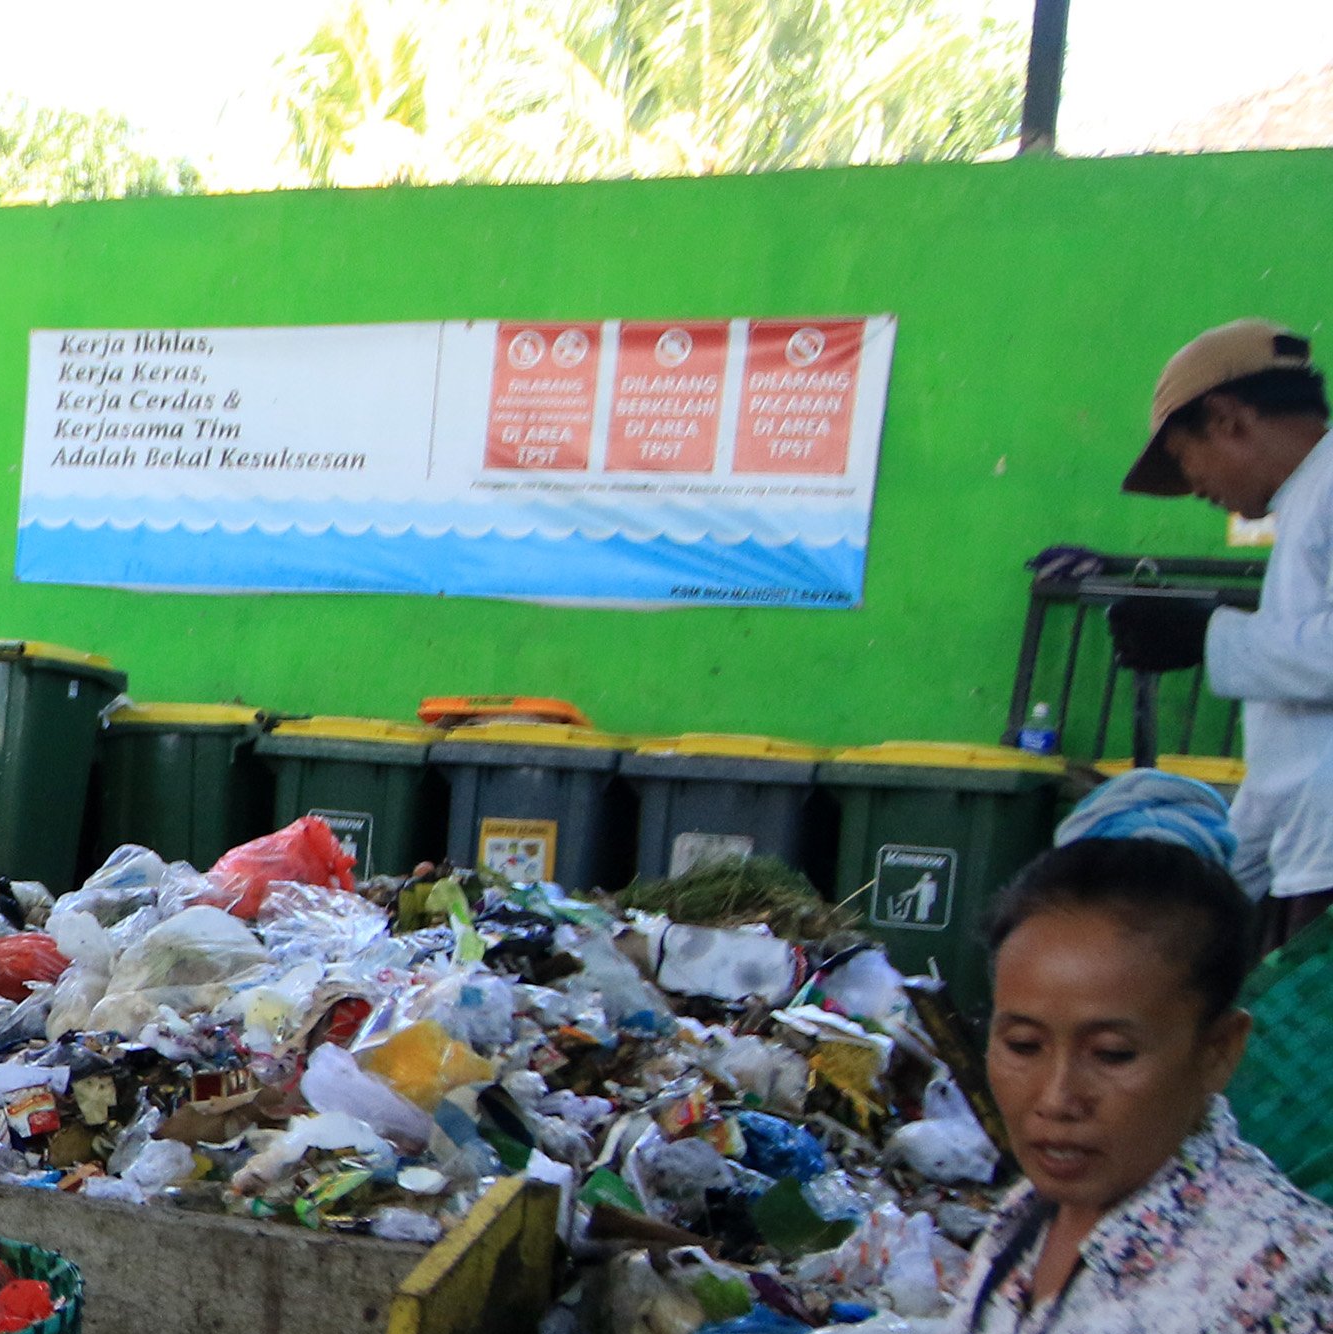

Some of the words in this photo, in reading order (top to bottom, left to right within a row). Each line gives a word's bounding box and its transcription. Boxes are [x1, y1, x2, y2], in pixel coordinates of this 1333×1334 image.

[58, 333, 126, 358] Kerja
[133, 331, 214, 358] Ikhlas,
[58, 361, 124, 386] Kerja
[132, 361, 209, 385] Keras,
[621, 375, 717, 394] DILARANG
[749, 371, 851, 392] DILARANG
[55, 389, 121, 414] Kerja
[129, 389, 216, 411] Cerdas
[222, 389, 241, 411] &
[54, 417, 184, 443] Kerjasama
[195, 417, 242, 440] Tim
[501, 425, 522, 444] DI
[523, 425, 573, 444] AREA
[624, 419, 646, 438] DI
[753, 416, 775, 436] DI
[777, 417, 831, 436] AREA
[50, 446, 135, 469] Adalah
[144, 446, 212, 469] Bekal
[218, 446, 367, 471] Kesuksesan
